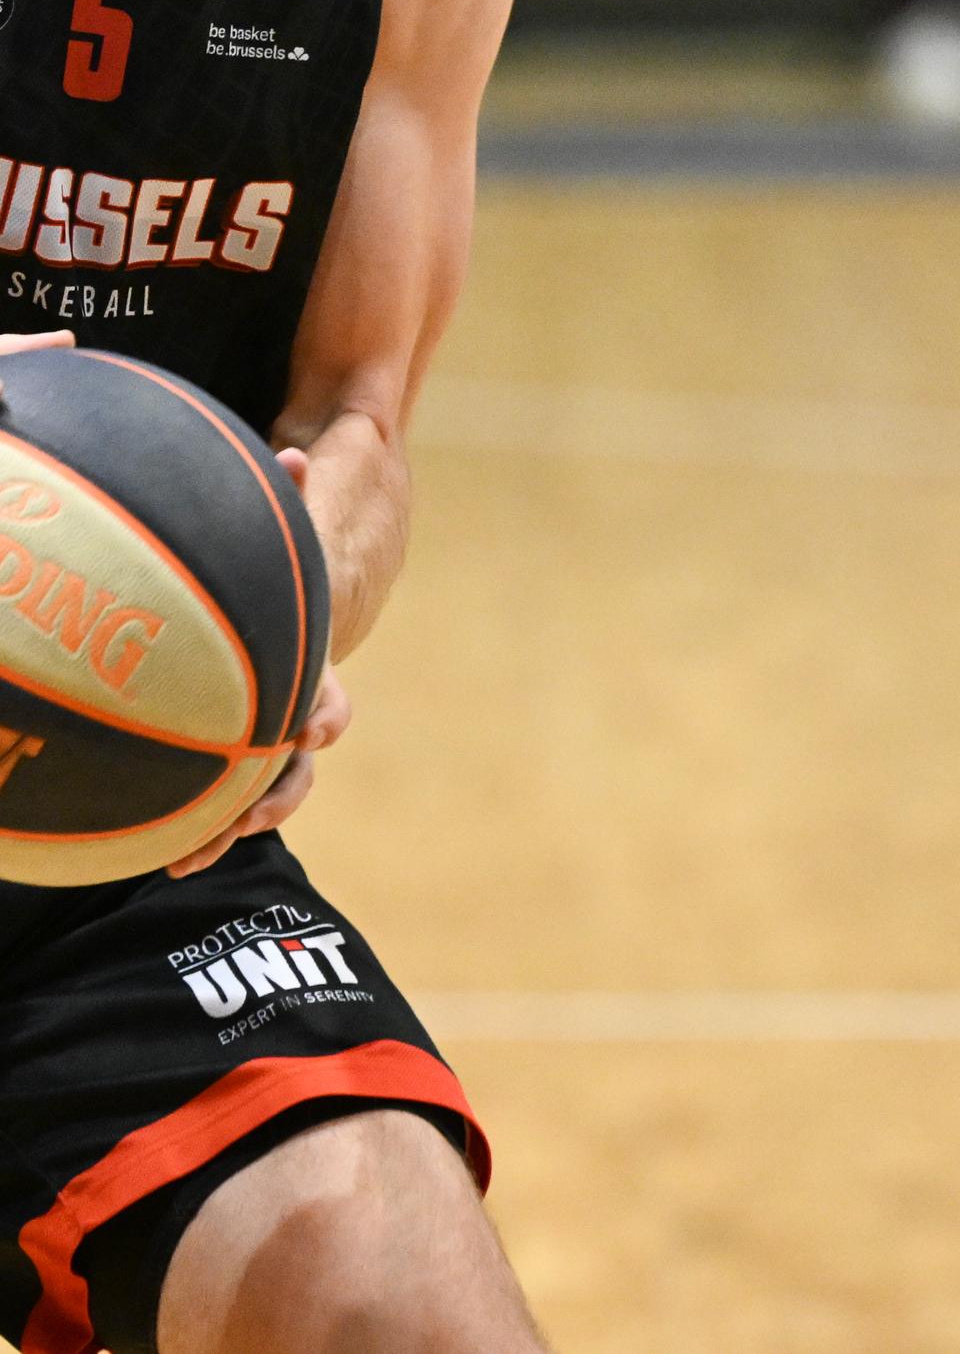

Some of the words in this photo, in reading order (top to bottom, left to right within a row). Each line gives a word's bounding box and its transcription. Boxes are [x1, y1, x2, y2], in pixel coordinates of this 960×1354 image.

[209, 22, 226, 39] be
[229, 25, 276, 42] basket
[167, 904, 312, 969] PROTECTI
[217, 1002, 277, 1046] EXPERT
[279, 994, 301, 1011] IN
[304, 989, 375, 1004] SERENITY
